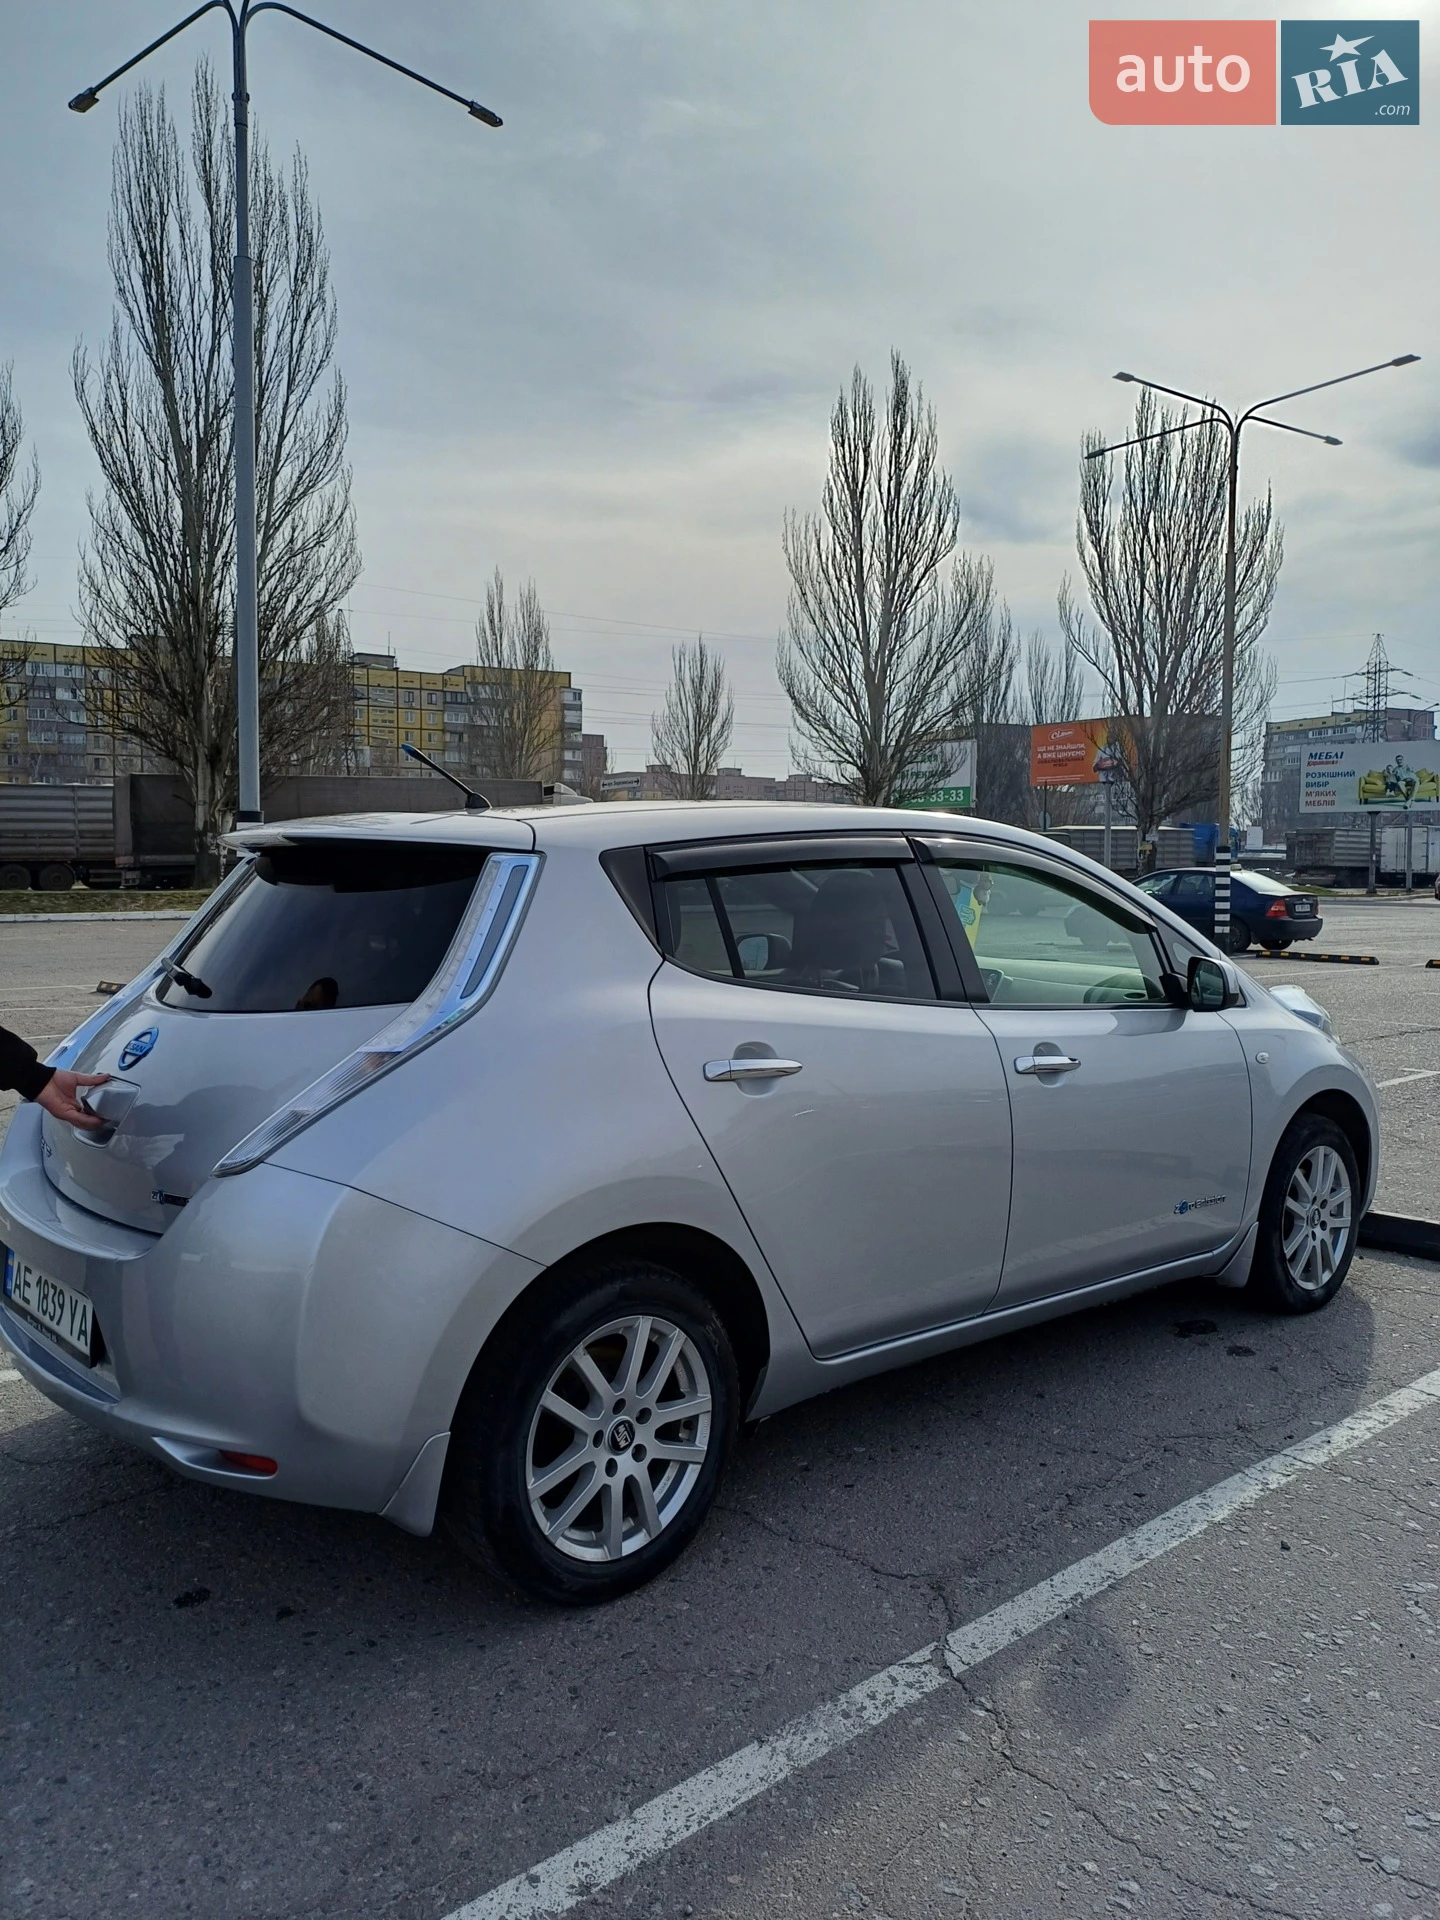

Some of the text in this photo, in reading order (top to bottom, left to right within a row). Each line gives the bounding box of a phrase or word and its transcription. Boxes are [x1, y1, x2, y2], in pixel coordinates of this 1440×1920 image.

[1308, 751, 1344, 760] МЕБЛІ
[1305, 770, 1356, 779] РОЗКІШНИЙ
[13, 1261, 32, 1306] AE
[36, 1275, 65, 1326] 1839
[69, 1295, 88, 1347] YA
